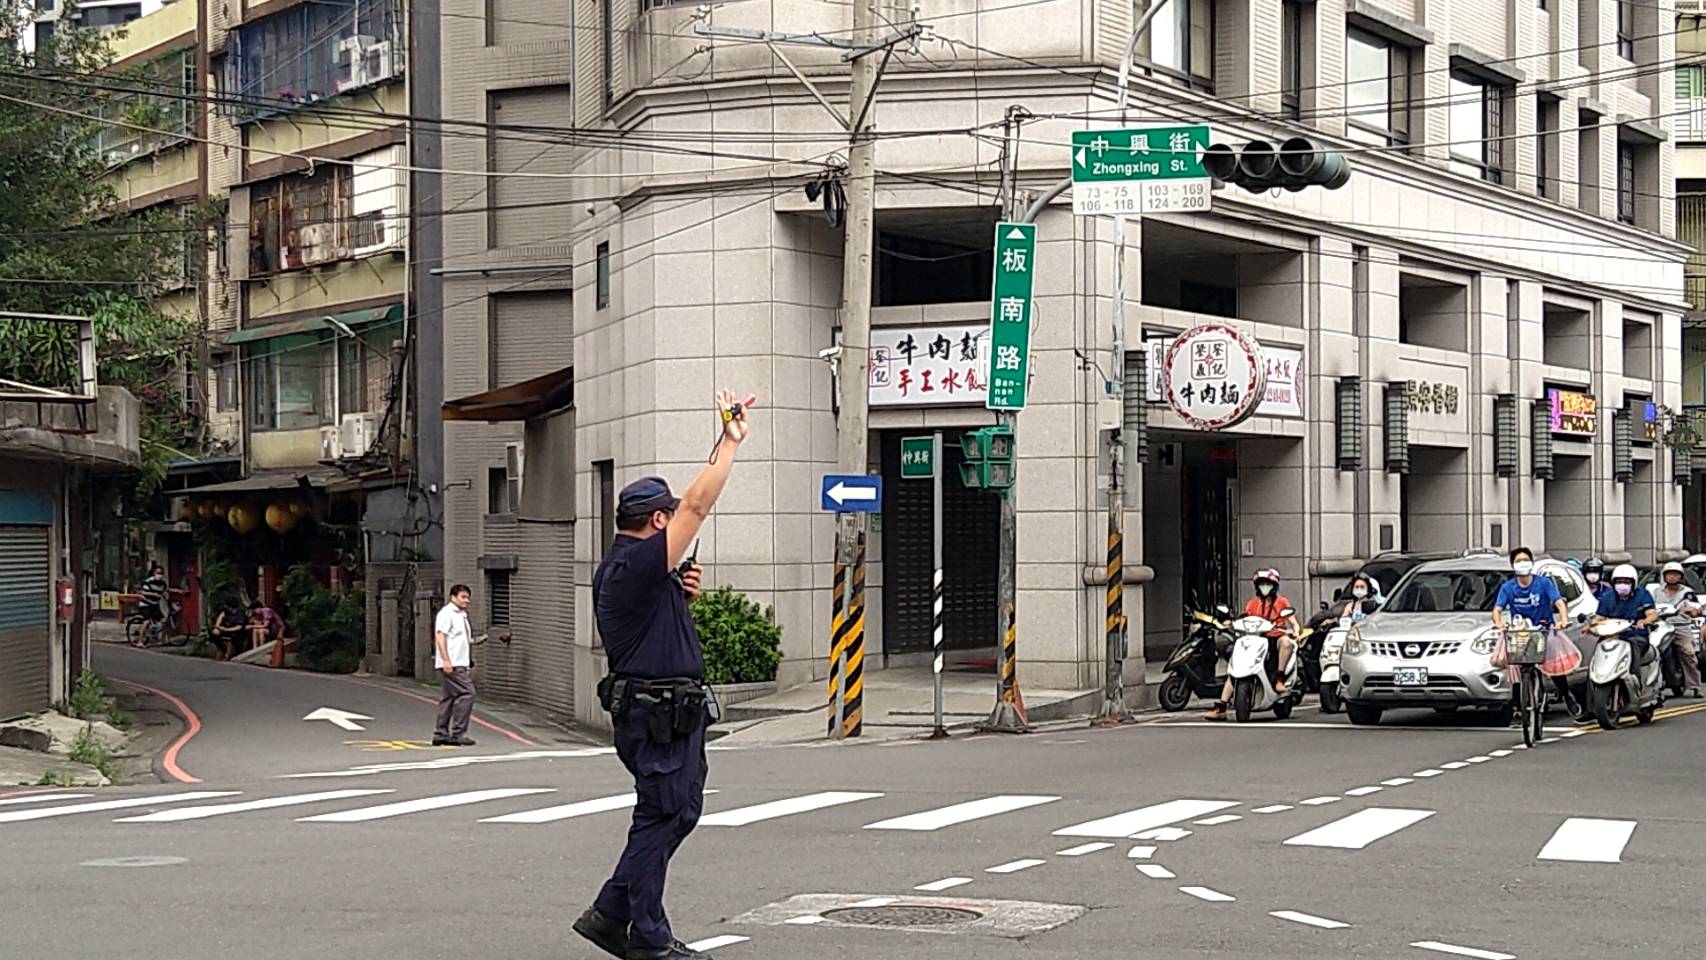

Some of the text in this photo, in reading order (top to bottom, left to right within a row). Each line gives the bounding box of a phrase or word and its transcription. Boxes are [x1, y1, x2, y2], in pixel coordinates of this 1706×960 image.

[1090, 132, 1190, 158] 中興街
[1092, 158, 1189, 176] Zhongxing St.
[995, 248, 1027, 371] 板南路
[1180, 381, 1239, 407] 牛肉麵
